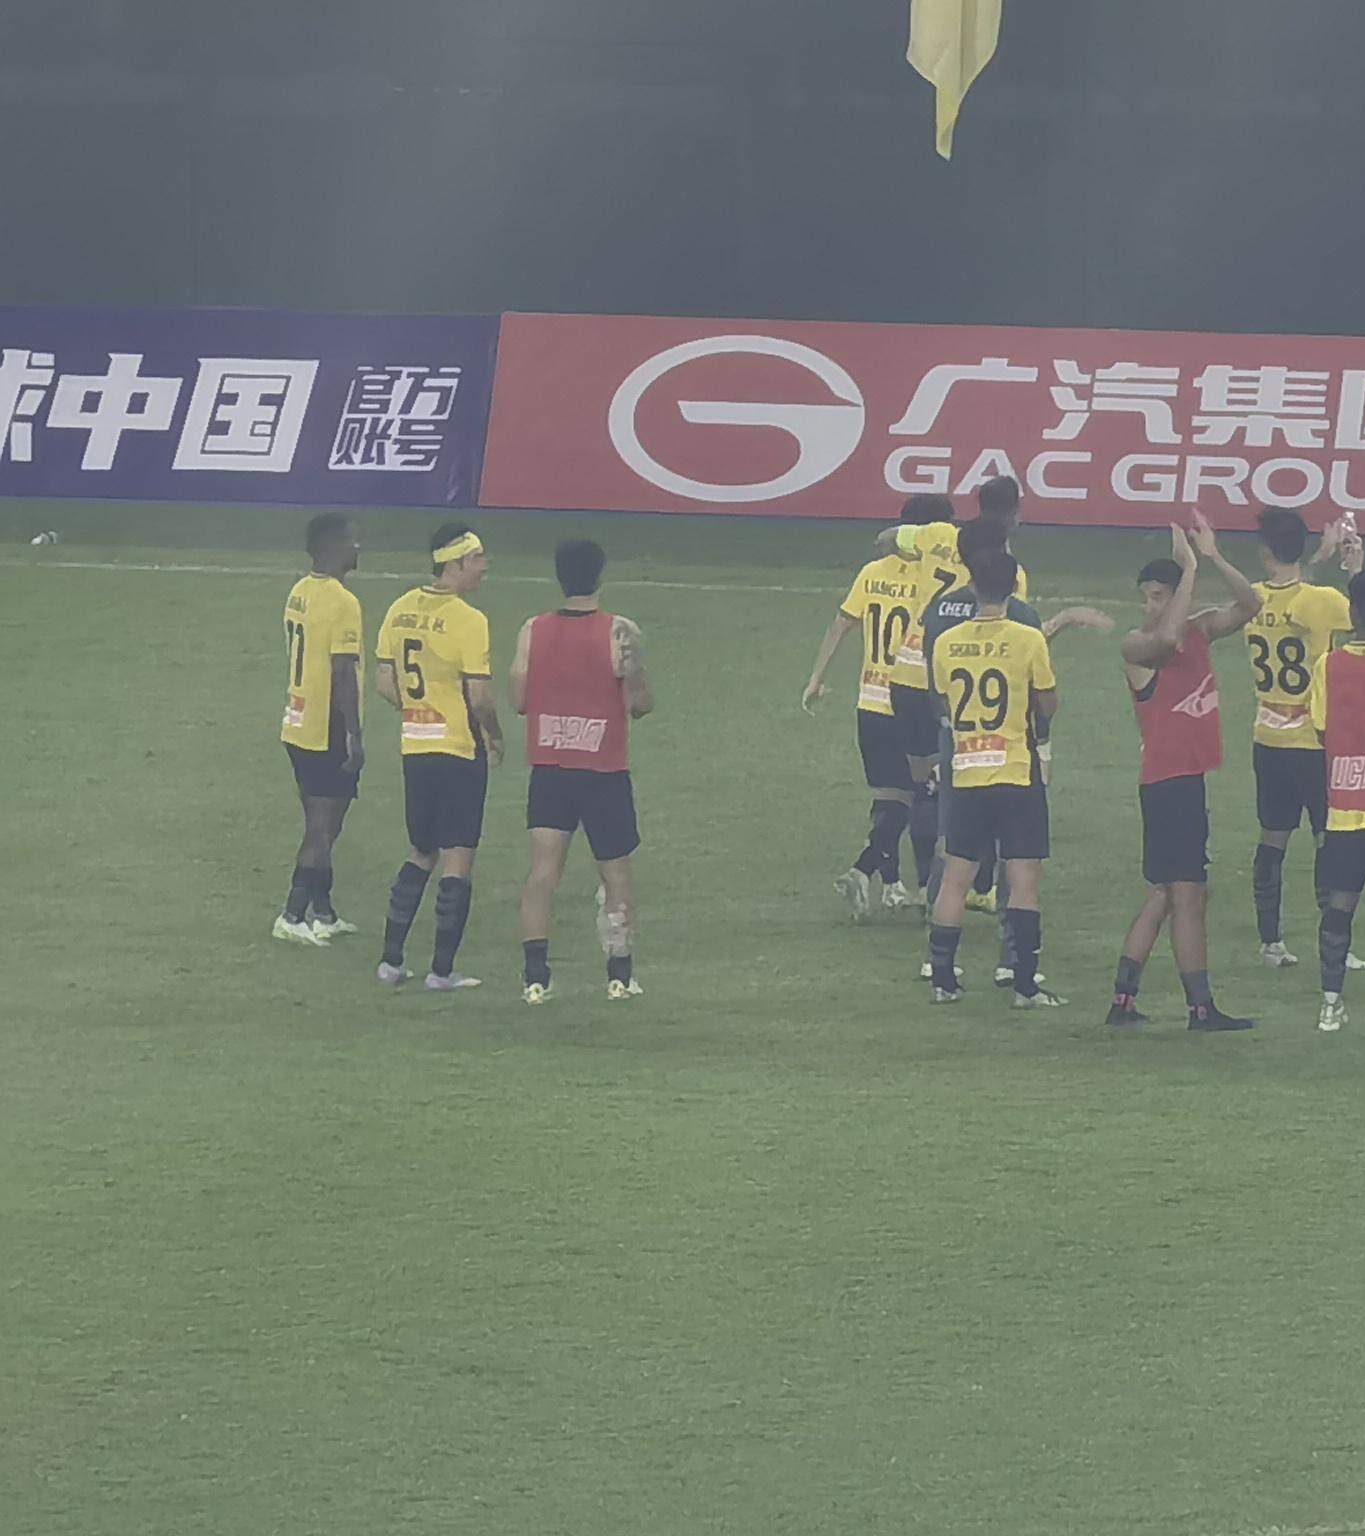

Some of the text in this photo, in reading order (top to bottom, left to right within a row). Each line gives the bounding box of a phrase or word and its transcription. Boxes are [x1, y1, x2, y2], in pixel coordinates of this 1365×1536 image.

[883, 445, 1093, 500] GAC
[868, 602, 911, 666] 10
[1248, 635, 1311, 697] 38
[403, 637, 425, 701] 5
[950, 667, 1009, 732] 29
